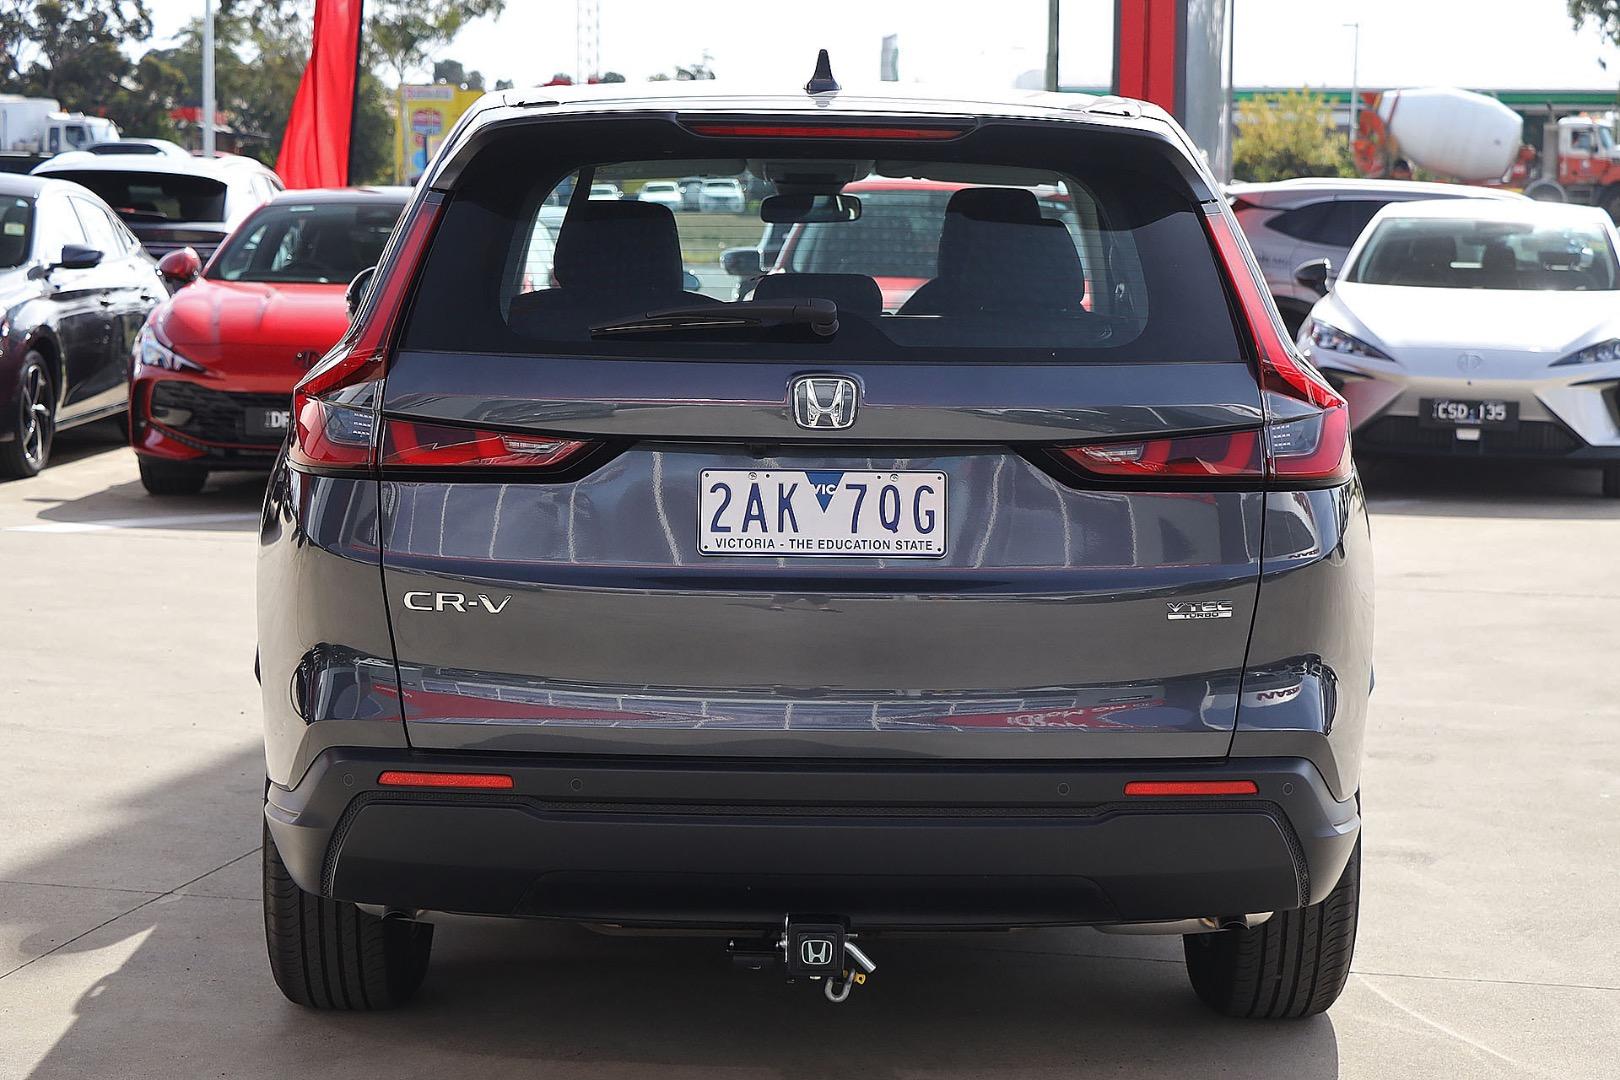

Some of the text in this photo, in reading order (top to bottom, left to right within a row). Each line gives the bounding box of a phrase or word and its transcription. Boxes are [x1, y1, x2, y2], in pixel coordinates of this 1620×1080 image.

[1438, 403, 1468, 419] CSD
[1479, 404, 1506, 420] 135
[812, 483, 837, 495] VIC
[710, 482, 935, 534] 2AK 7QG
[715, 538, 775, 549] VICTORIA
[789, 539, 813, 549] THE
[818, 539, 891, 550] EDUCATION
[895, 540, 933, 551] STATE
[403, 590, 512, 614] CR-V
[1166, 600, 1233, 612] VTEC
